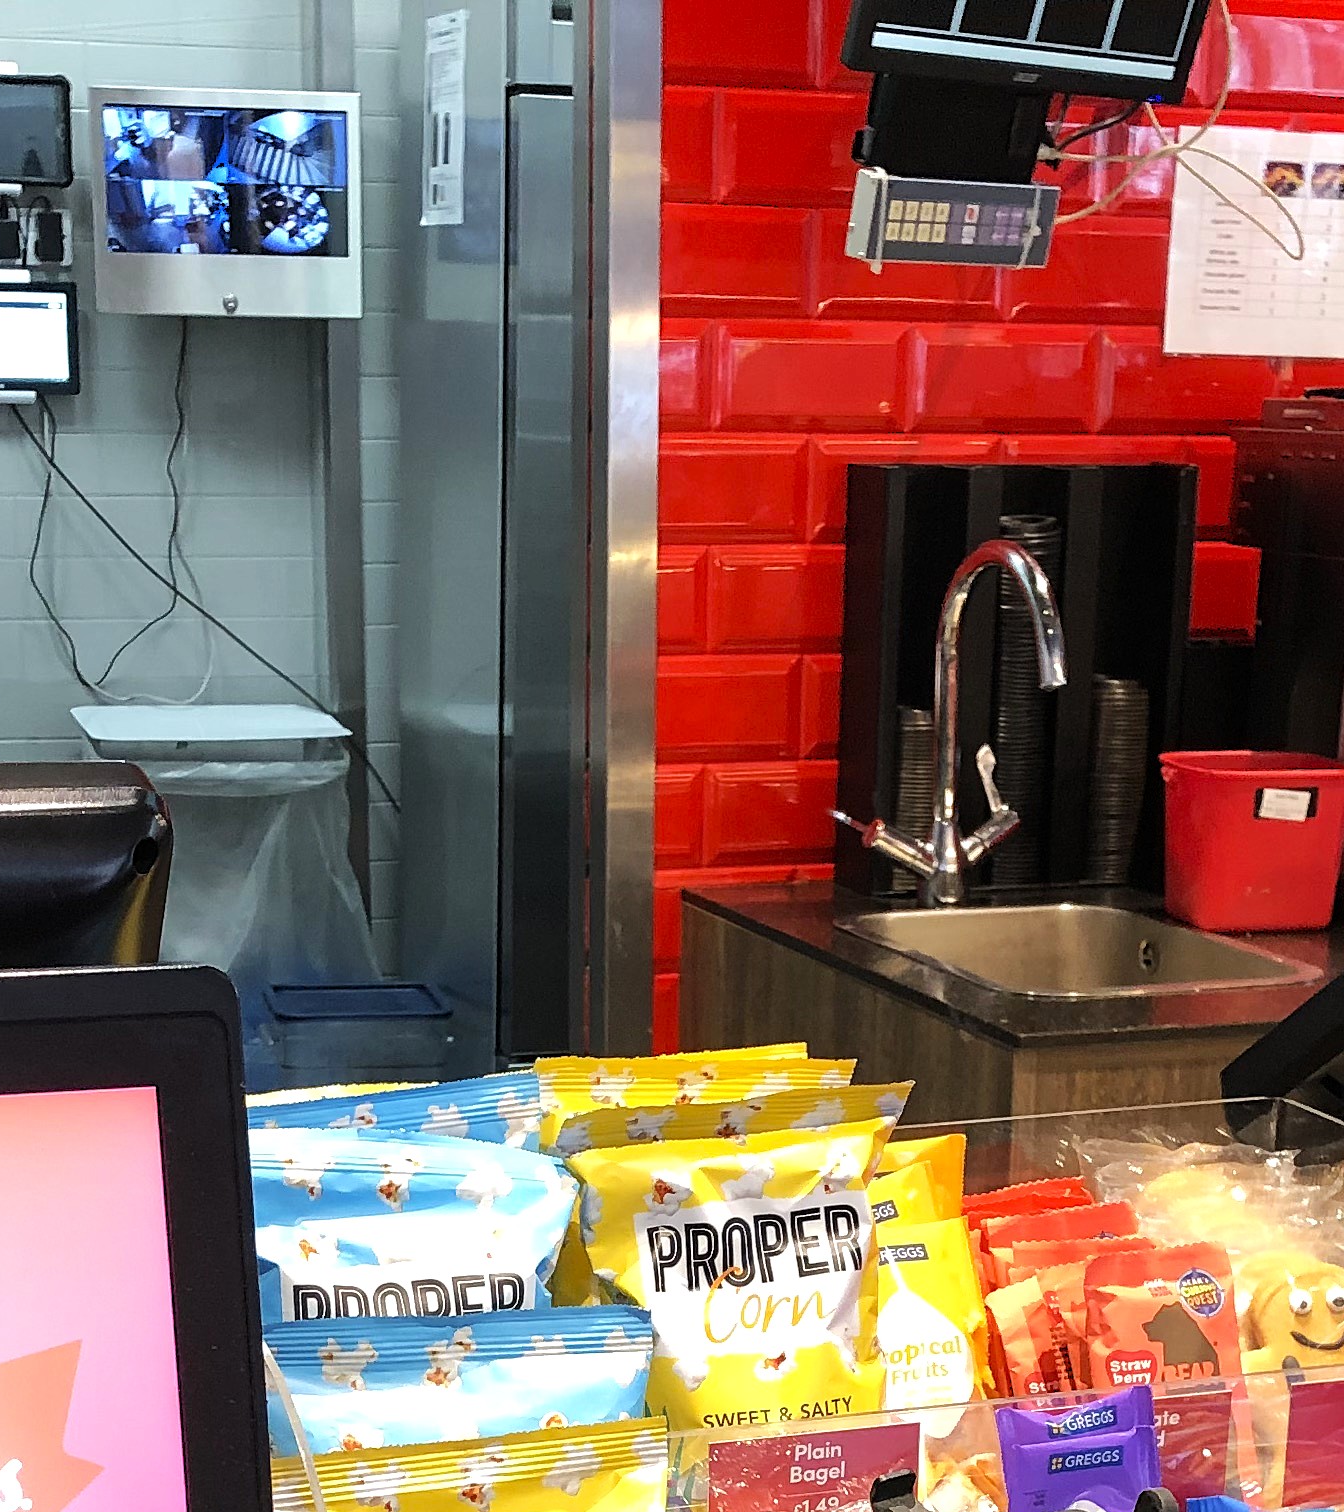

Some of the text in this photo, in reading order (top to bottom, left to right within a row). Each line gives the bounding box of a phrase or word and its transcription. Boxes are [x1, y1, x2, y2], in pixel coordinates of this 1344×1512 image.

[647, 1204, 863, 1293] PROPER
[878, 1246, 925, 1263] REGGS
[703, 1267, 839, 1344] Corn
[1186, 1290, 1219, 1309] QUEST
[1109, 1358, 1152, 1373] Straw
[1112, 1372, 1152, 1386] berry
[703, 1395, 853, 1429] SWEET & SALTY
[1065, 1409, 1115, 1432] GREGGS
[794, 1441, 842, 1462] Plain
[1064, 1448, 1120, 1469] GREGGS
[789, 1460, 846, 1486] Bagel
